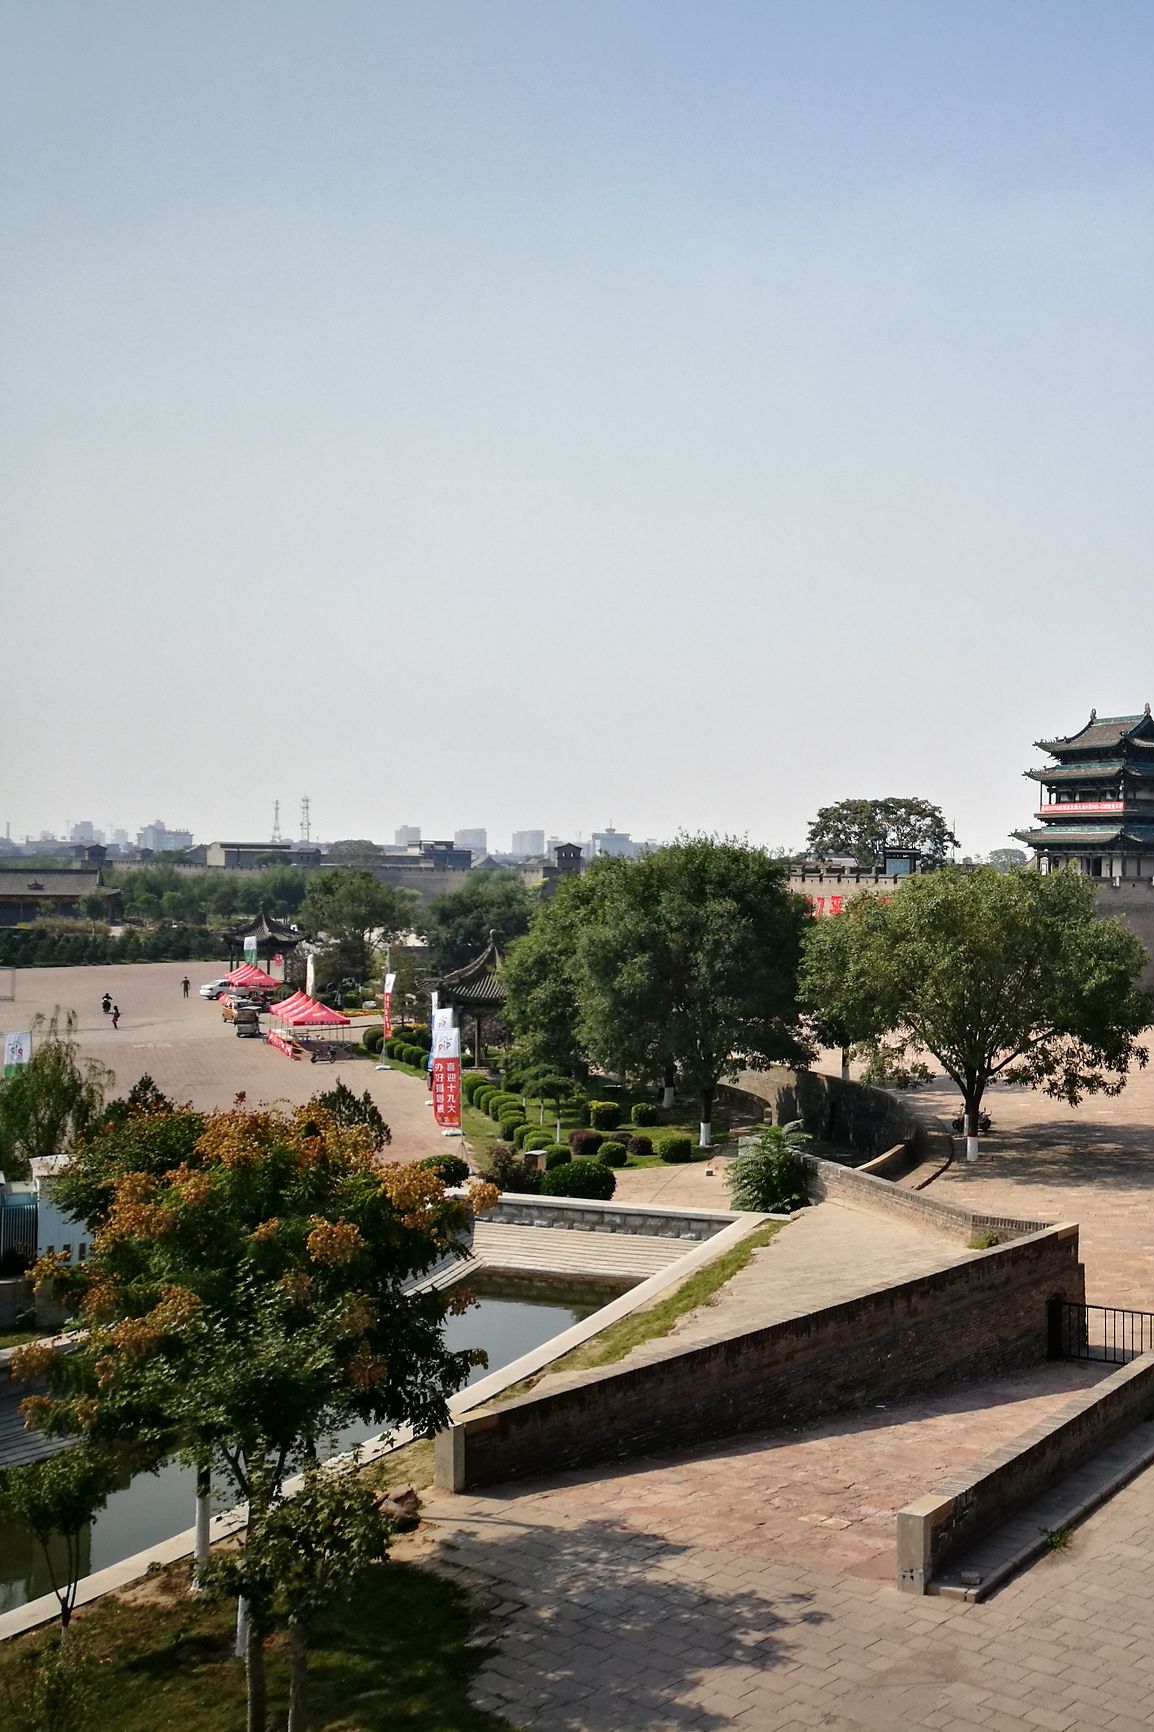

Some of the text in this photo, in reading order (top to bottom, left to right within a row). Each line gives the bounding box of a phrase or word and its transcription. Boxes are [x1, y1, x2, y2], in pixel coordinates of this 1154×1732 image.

[446, 1062, 456, 1113] 喜迎十九大
